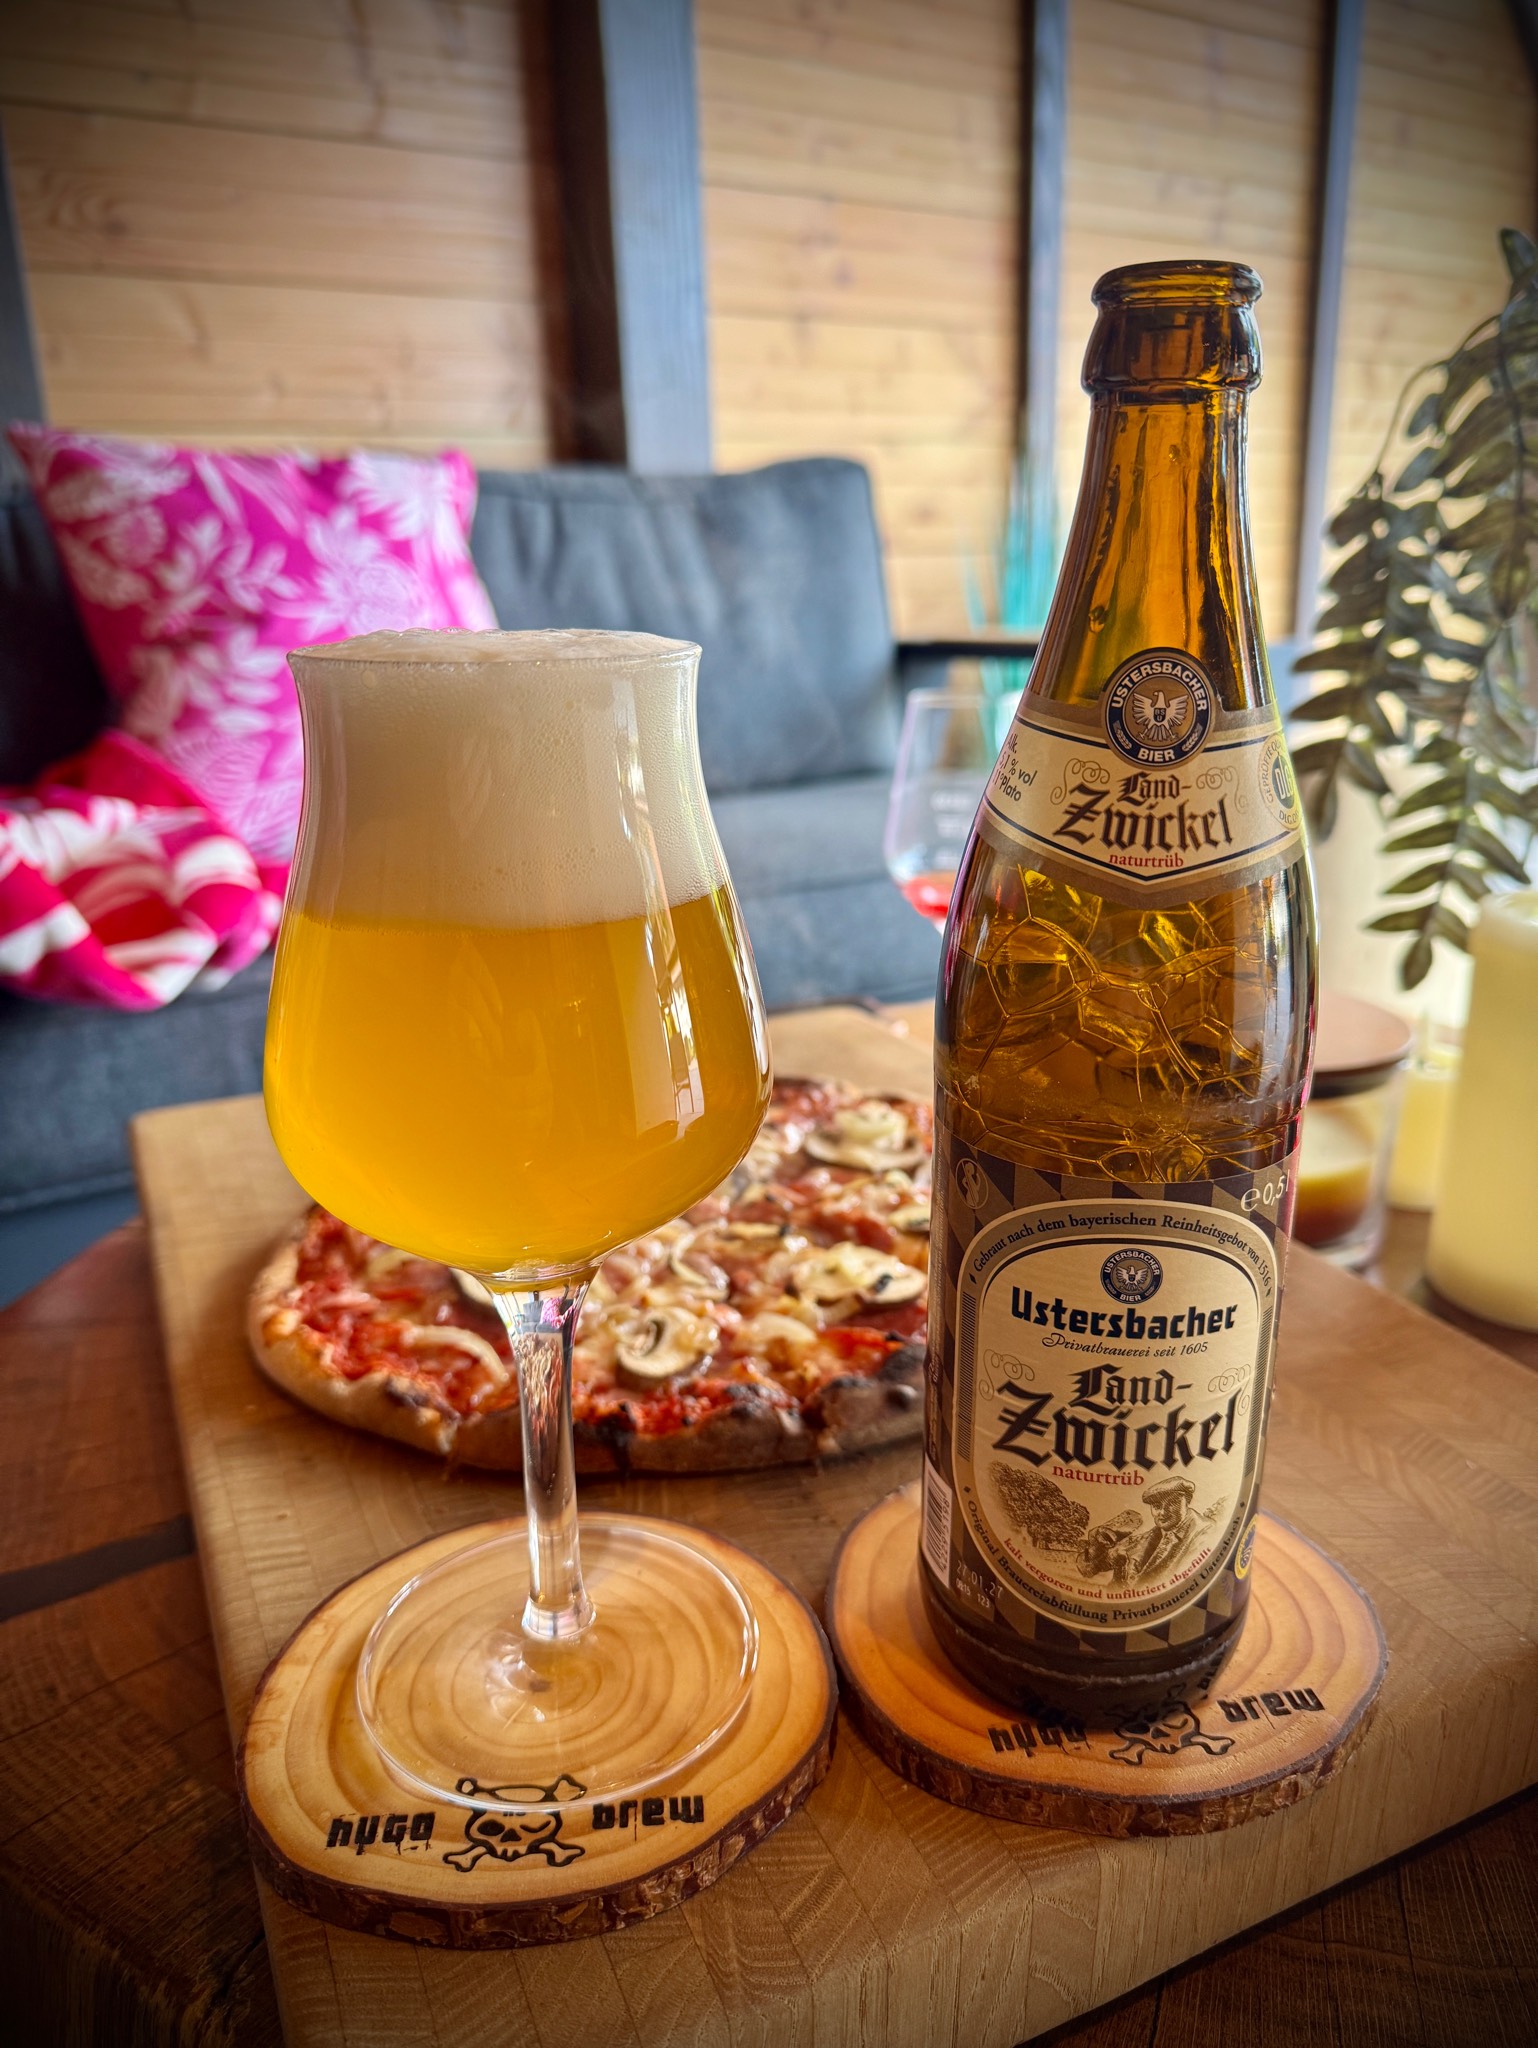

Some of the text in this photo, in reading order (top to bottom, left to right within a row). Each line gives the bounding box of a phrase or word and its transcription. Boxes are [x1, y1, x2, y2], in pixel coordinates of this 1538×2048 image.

[1111, 662, 1207, 711] USTERSBACHER
[1138, 747, 1175, 762] BIER
[1018, 769, 1038, 787] vol
[1117, 771, 1192, 807] Land-
[1053, 783, 1232, 853] Zwickel
[1109, 853, 1184, 869] naturtrüb
[973, 1212, 1272, 1286] Gebraut nach dem bayerischen Reinheitsgebot von 1516
[1104, 1251, 1160, 1275] USTERSBACHER
[1011, 1286, 1238, 1340] Ustersbacher
[1119, 1293, 1142, 1302] BIER
[1042, 1332, 1208, 1357] Privatbrauerei seit 1605
[1067, 1363, 1194, 1416] Land-
[992, 1380, 1243, 1472] Zwickel
[1051, 1464, 1144, 1486] naturtrüb
[968, 1500, 1000, 1555] Original
[998, 1556, 1108, 1623] Brauereiabfüllung
[1112, 1579, 1199, 1621] Privatbrauerei
[1200, 1517, 1240, 1579] Ustersbach
[1004, 1538, 1211, 1600] kalt vergoren und unfiltriert abgefüllt
[1217, 1688, 1325, 1724] brew
[592, 1795, 704, 1831] brew
